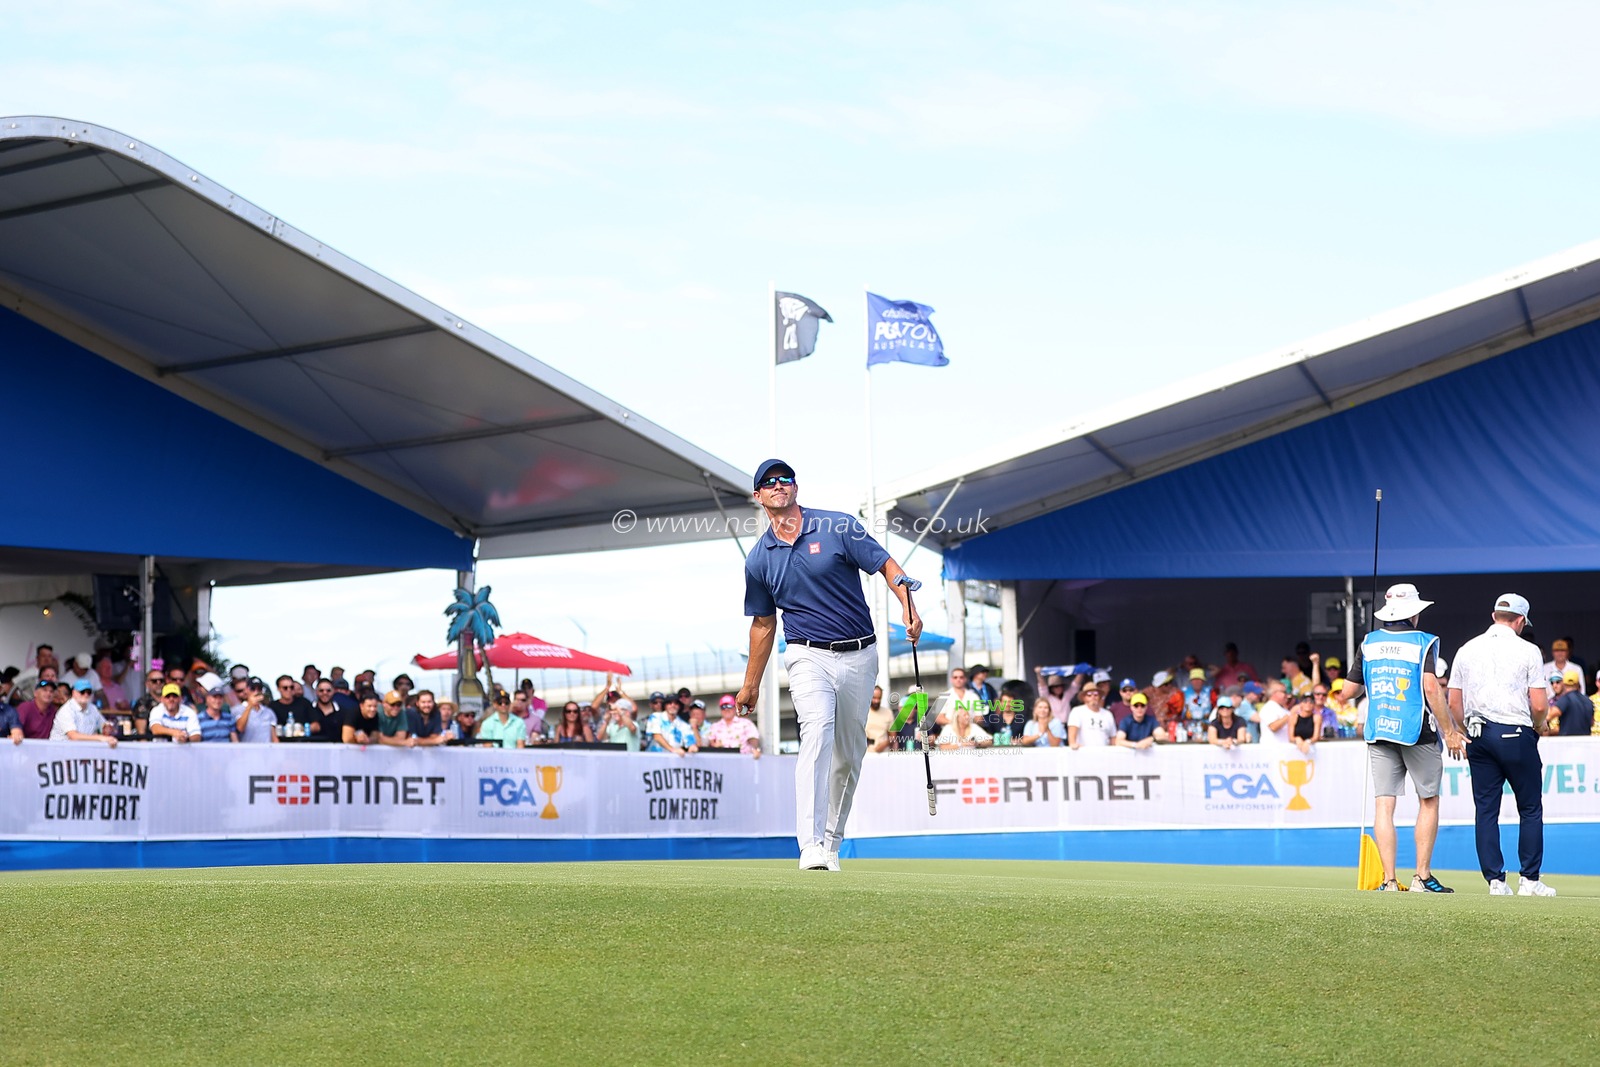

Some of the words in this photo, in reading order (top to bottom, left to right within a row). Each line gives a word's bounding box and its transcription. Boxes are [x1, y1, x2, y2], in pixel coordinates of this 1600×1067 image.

[902, 322, 937, 343] TOU
[1380, 645, 1402, 655] SYME
[37, 759, 149, 790] SOUTHERN
[478, 766, 529, 774] AUSTRALIAN
[643, 768, 723, 794] SOUTHERN
[249, 774, 446, 805] FORTINET
[479, 778, 537, 806] PGA
[931, 775, 1161, 805] FORTINET
[1204, 773, 1280, 799] PGA
[44, 794, 141, 821] COMFORT
[478, 810, 539, 818] CHAMPIONSHIP
[649, 798, 718, 820] COMFORT
[1204, 803, 1283, 811] CHAMPIONSHIP
